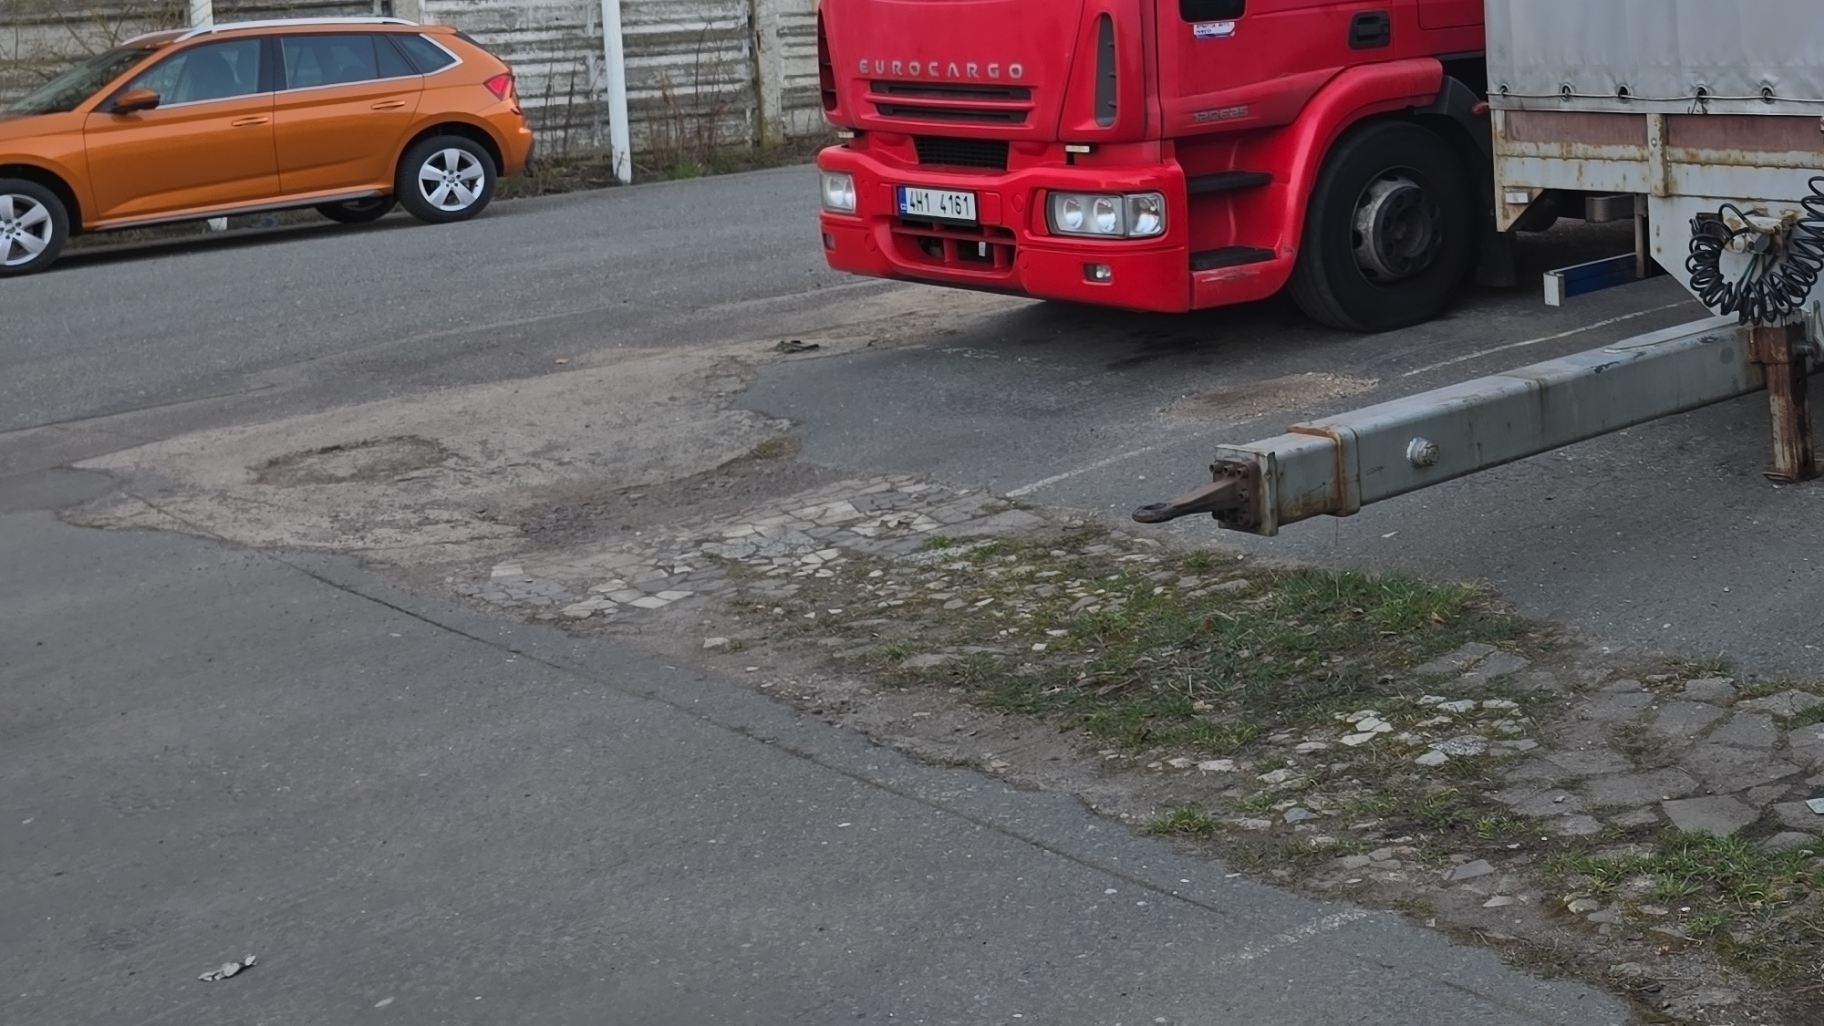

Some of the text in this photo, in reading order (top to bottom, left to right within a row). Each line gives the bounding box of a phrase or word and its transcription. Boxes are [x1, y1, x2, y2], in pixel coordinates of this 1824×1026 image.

[859, 59, 1023, 79] EUROCARGO
[910, 190, 969, 216] 4H1 4161
